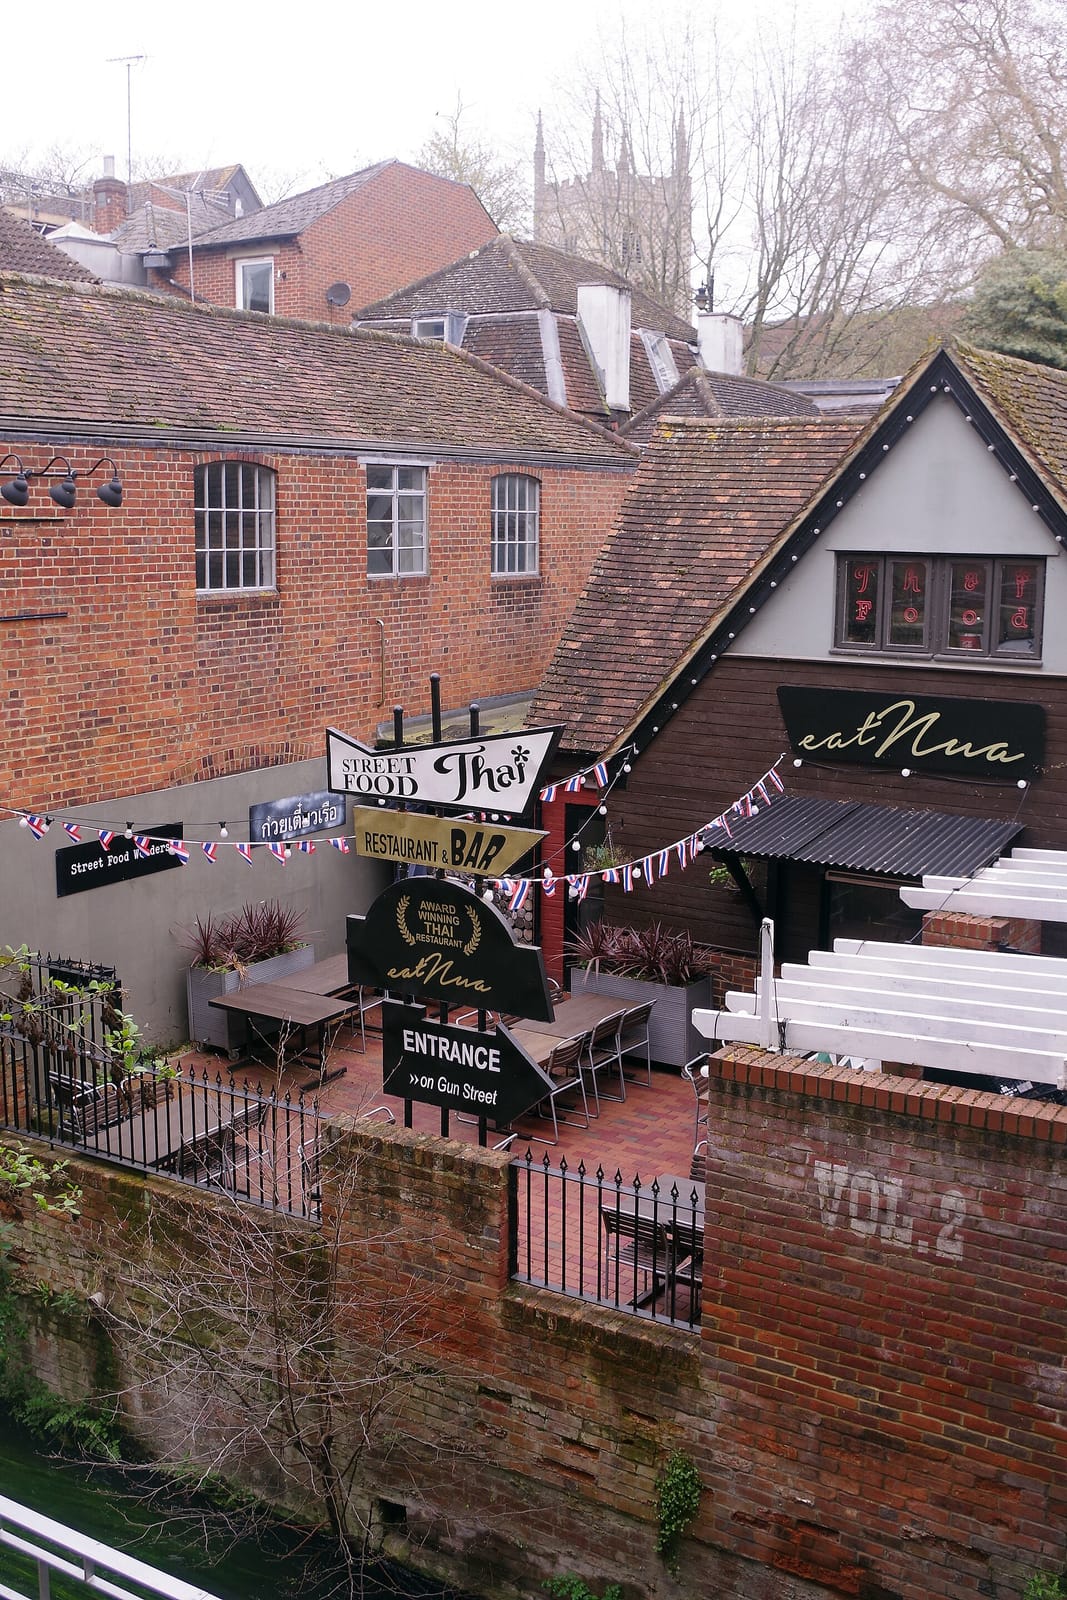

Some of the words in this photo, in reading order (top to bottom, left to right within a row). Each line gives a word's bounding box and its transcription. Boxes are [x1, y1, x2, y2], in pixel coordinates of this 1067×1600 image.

[342, 757, 417, 774] STREET
[433, 745, 531, 802] Thai
[343, 774, 419, 797] FOOD
[364, 831, 439, 863] RESTAURANT
[441, 849, 449, 865] &
[450, 828, 506, 871] BAR
[70, 857, 104, 875] Street
[107, 851, 130, 867] Food
[417, 910, 460, 926] WINNING
[420, 900, 456, 914] AWARD
[415, 933, 464, 949] RESTAURANT
[423, 922, 454, 938] THAI
[402, 1028, 501, 1073] ENTRANCE
[437, 1076, 460, 1096] Gun
[462, 1083, 498, 1106] Street
